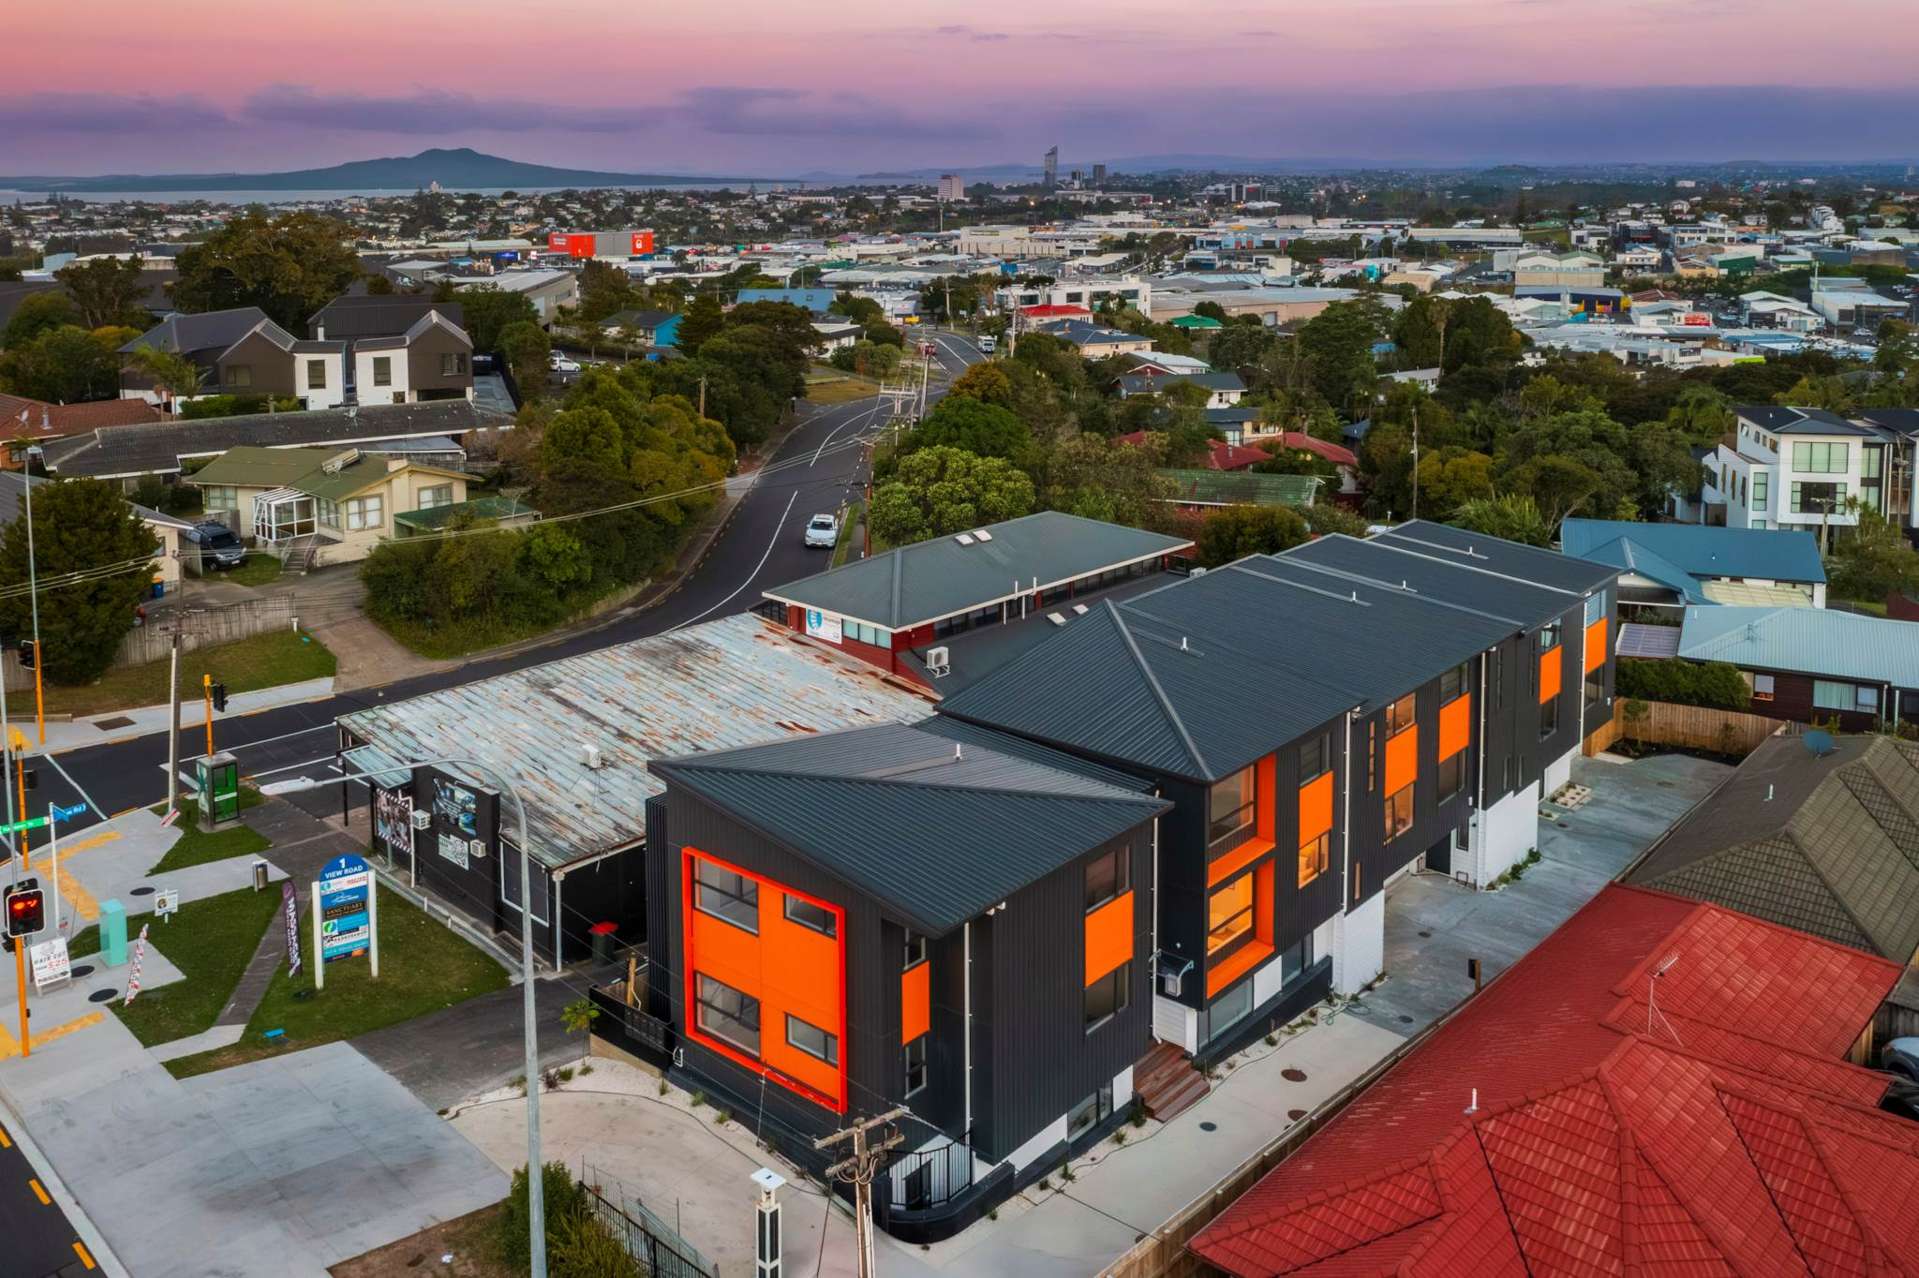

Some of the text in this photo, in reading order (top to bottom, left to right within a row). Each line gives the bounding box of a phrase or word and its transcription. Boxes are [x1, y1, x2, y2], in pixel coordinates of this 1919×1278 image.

[339, 857, 346, 868] 1
[325, 865, 363, 879] VIEW ROAD
